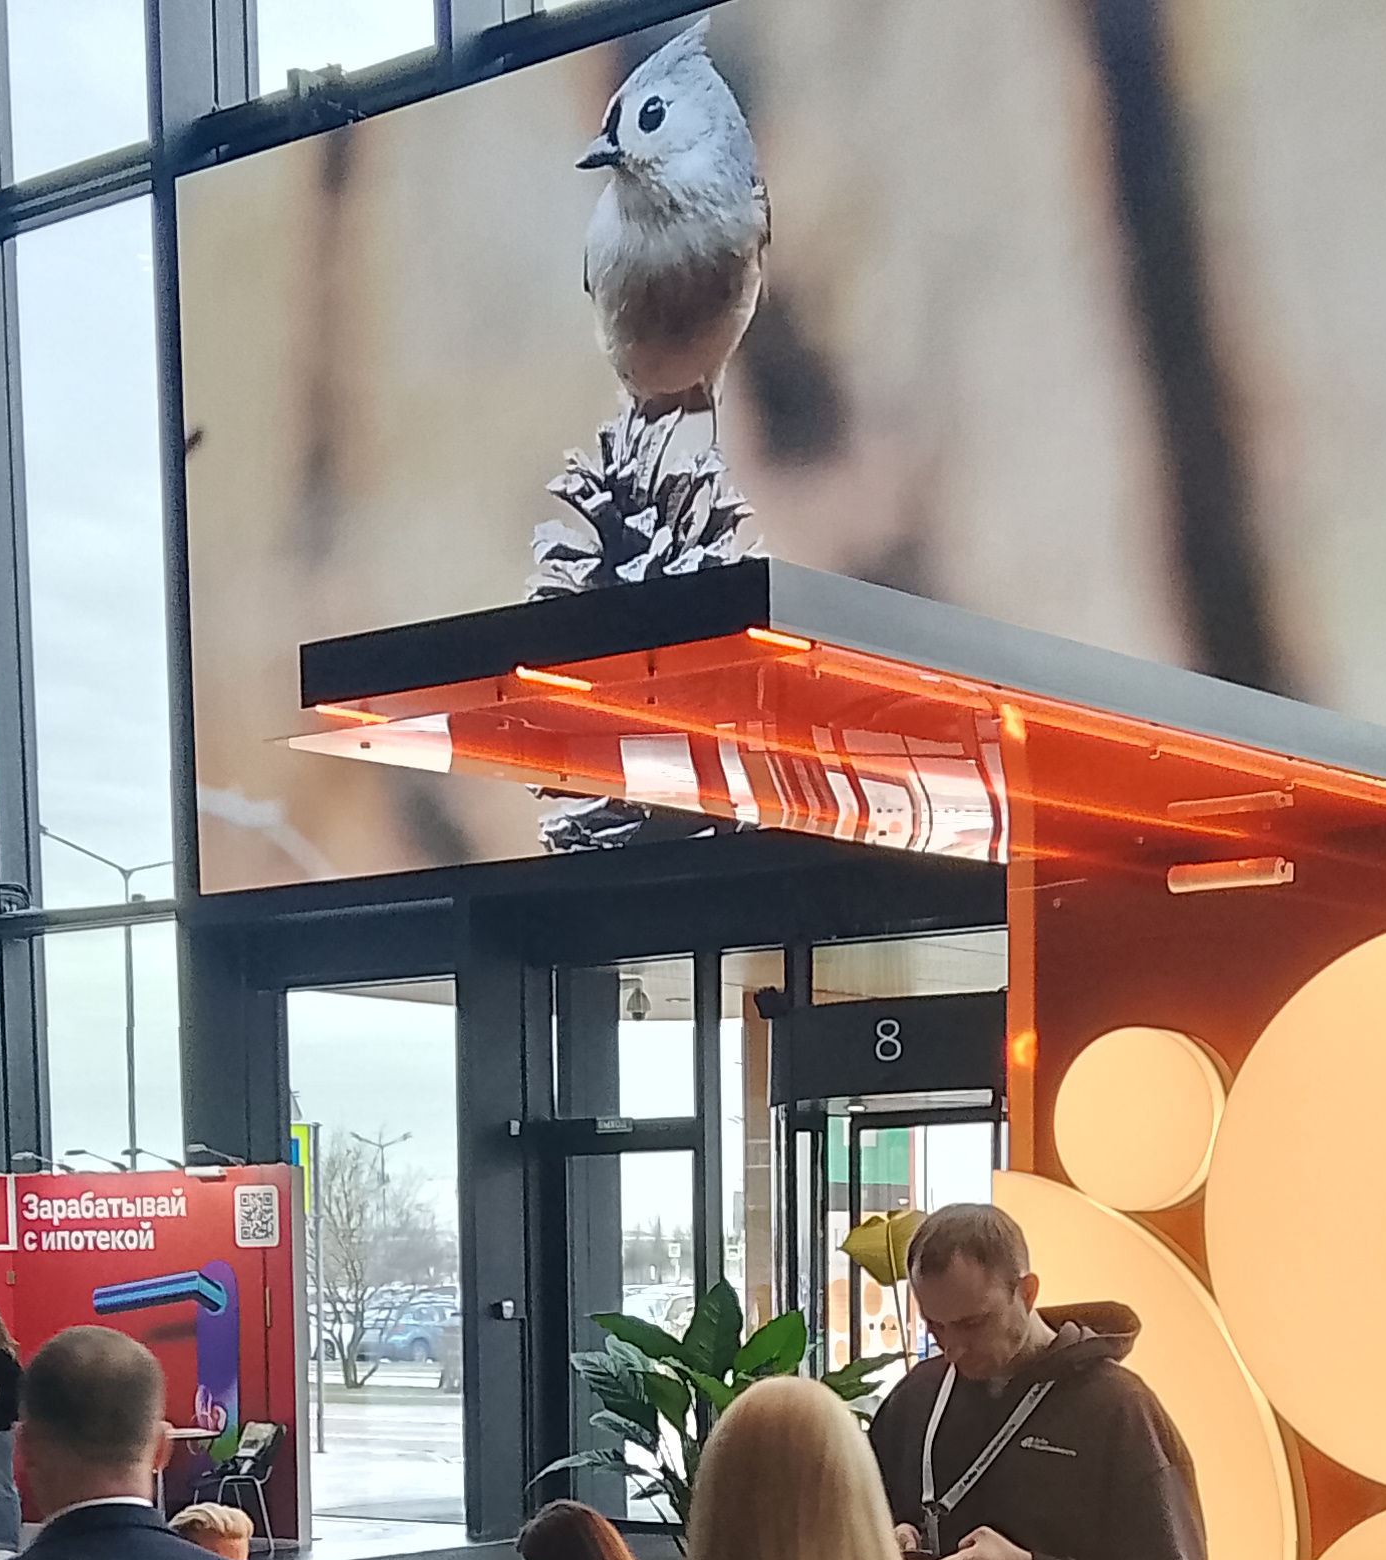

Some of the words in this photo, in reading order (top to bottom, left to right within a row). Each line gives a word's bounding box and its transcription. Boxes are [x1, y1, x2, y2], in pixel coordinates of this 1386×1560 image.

[875, 1018, 902, 1062] 8
[21, 1187, 188, 1226] Зарабатывай
[23, 1230, 39, 1252] с
[40, 1220, 156, 1252] ипотекой
